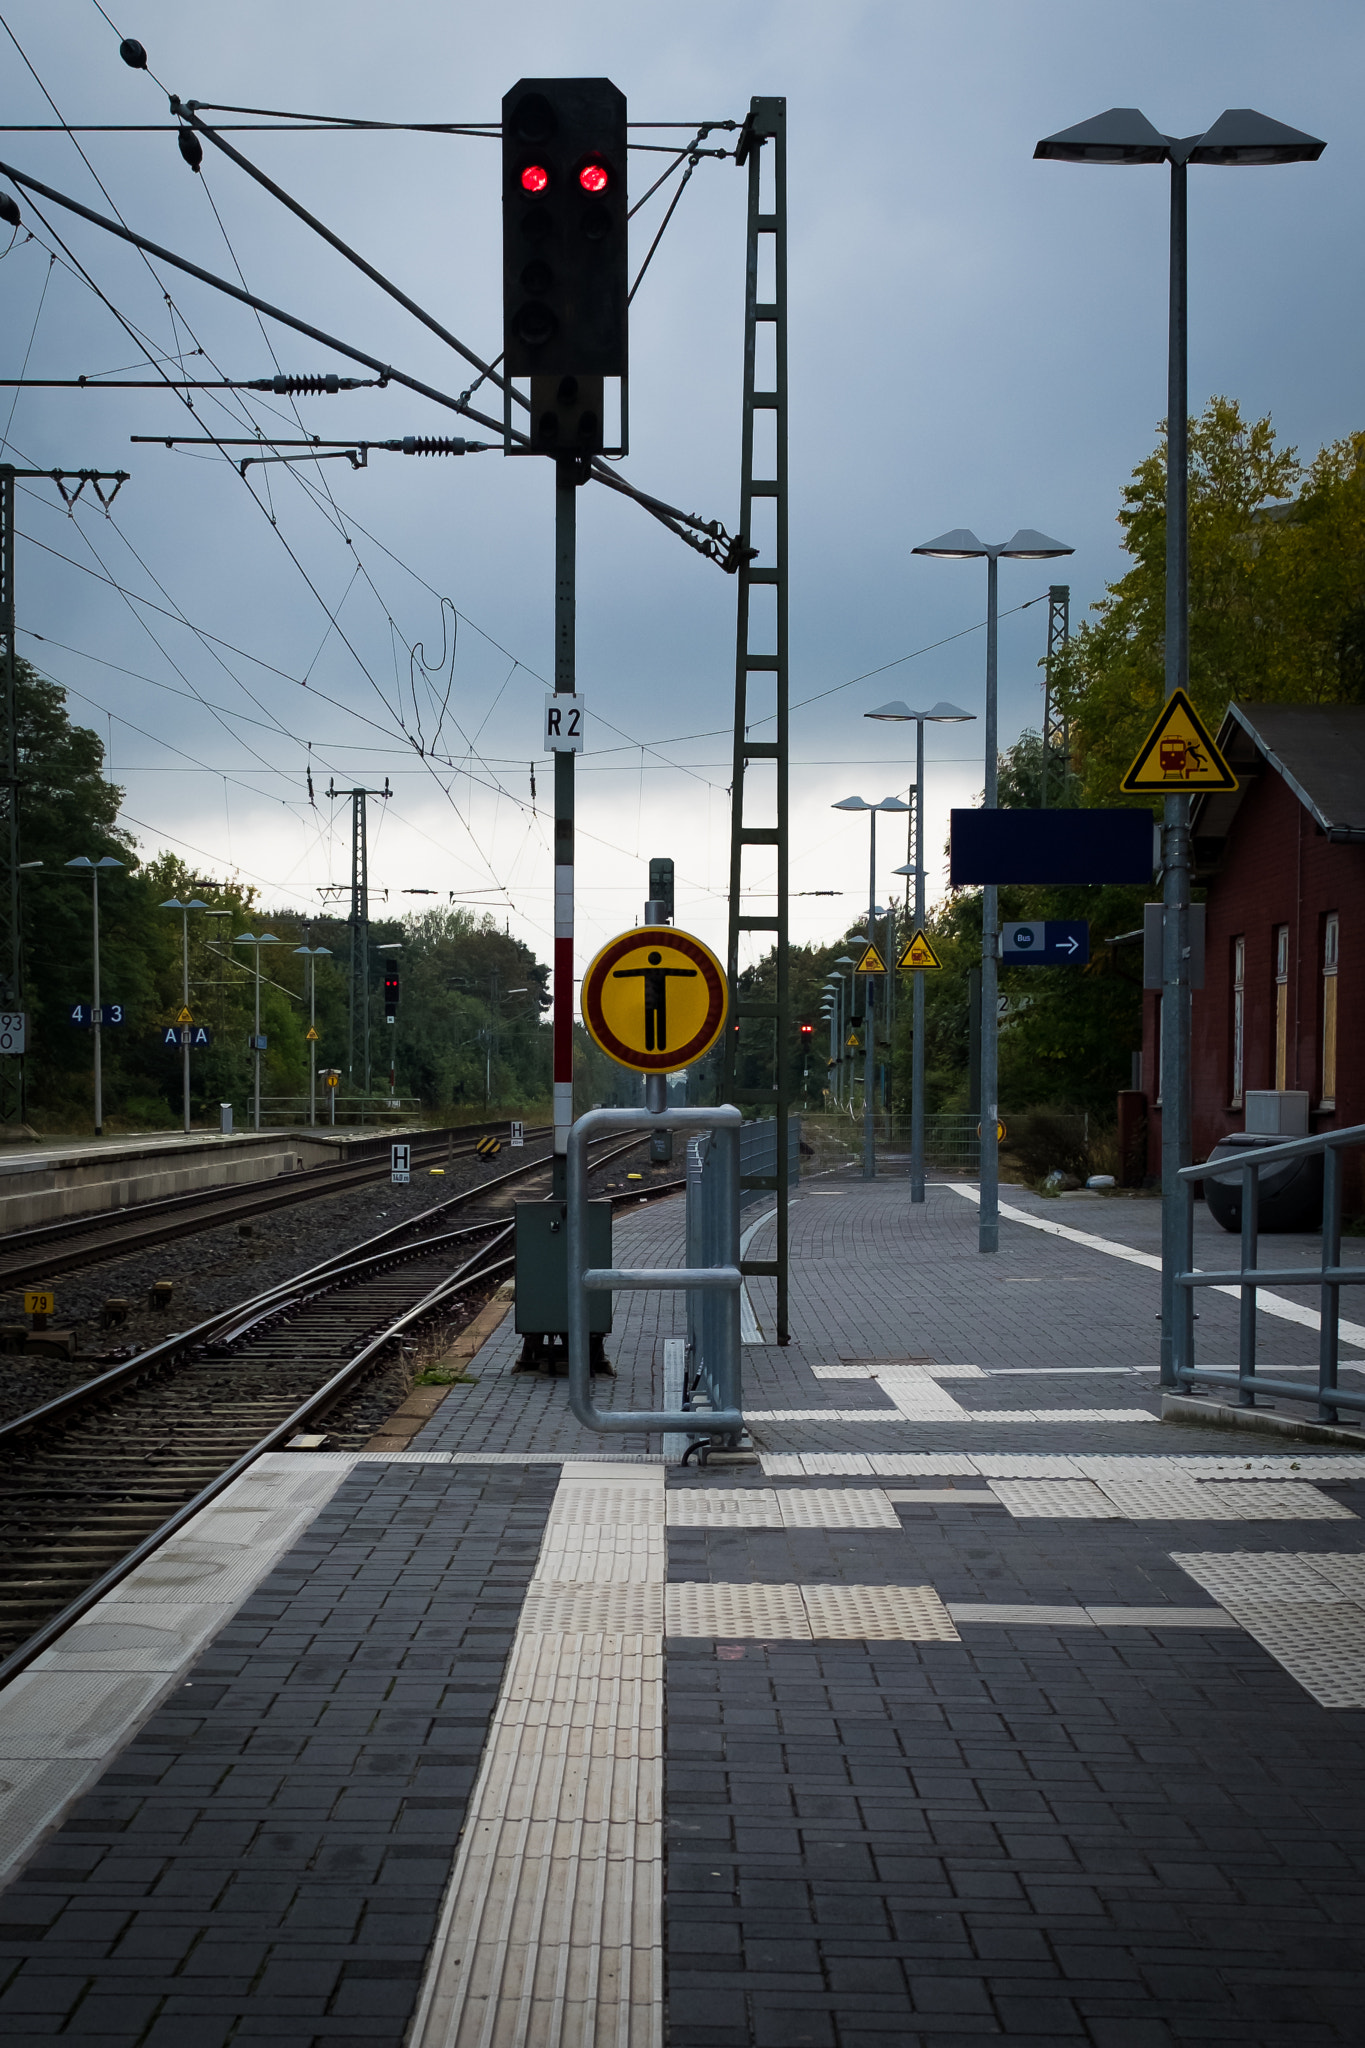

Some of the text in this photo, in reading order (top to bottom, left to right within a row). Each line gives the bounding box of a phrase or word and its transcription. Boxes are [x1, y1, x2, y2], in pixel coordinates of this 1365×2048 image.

[1017, 934, 1031, 942] Bus
[71, 1005, 83, 1022] 4
[111, 1005, 122, 1022] 3
[2, 1015, 22, 1031] 93
[165, 1028, 177, 1043] A
[195, 1028, 207, 1043] A
[513, 1123, 521, 1137] H
[394, 1147, 407, 1168] H
[32, 1296, 46, 1310] 79
